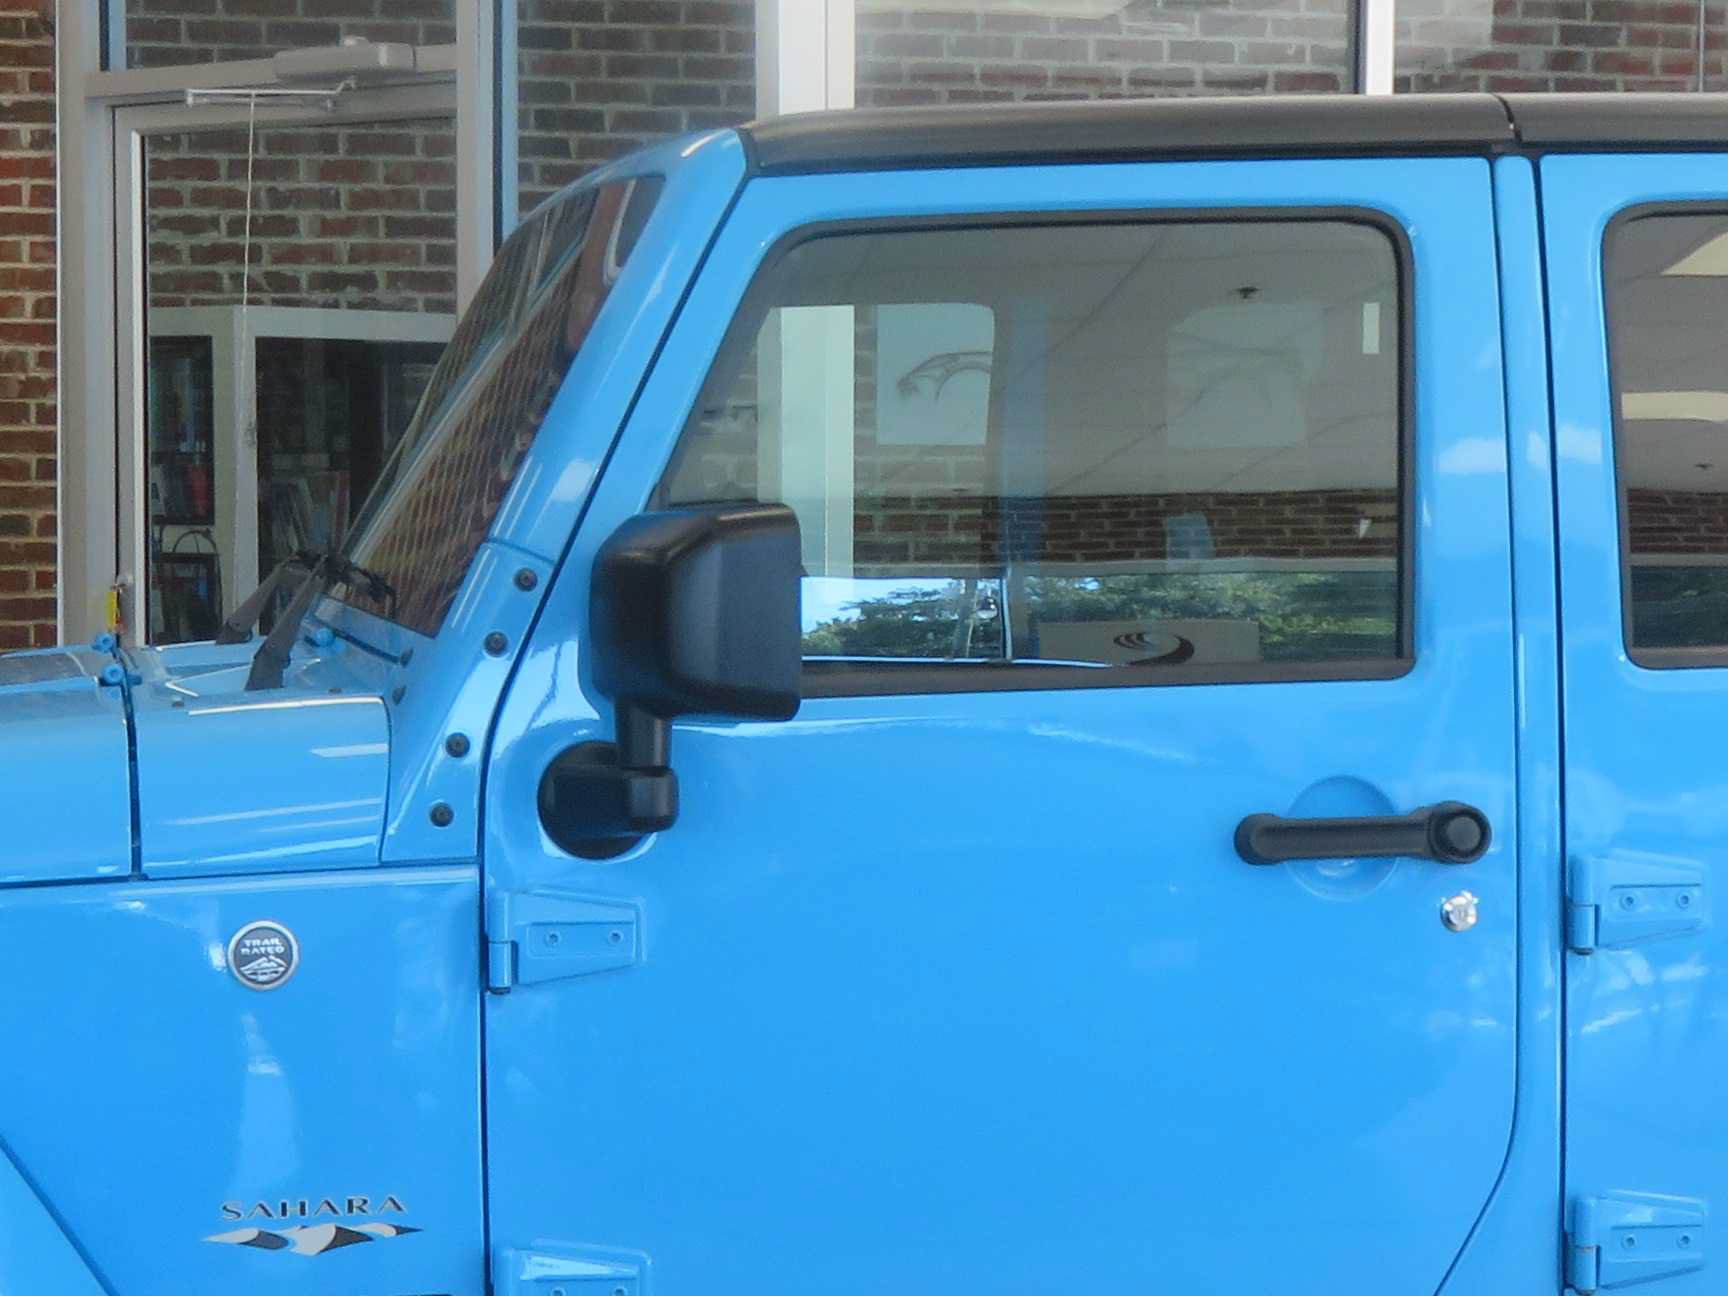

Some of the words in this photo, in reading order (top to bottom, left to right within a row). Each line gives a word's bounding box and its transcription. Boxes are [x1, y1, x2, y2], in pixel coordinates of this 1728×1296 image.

[244, 938, 282, 947] TRAIL
[240, 945, 285, 955] RATED
[221, 1195, 408, 1221] SAHARA
